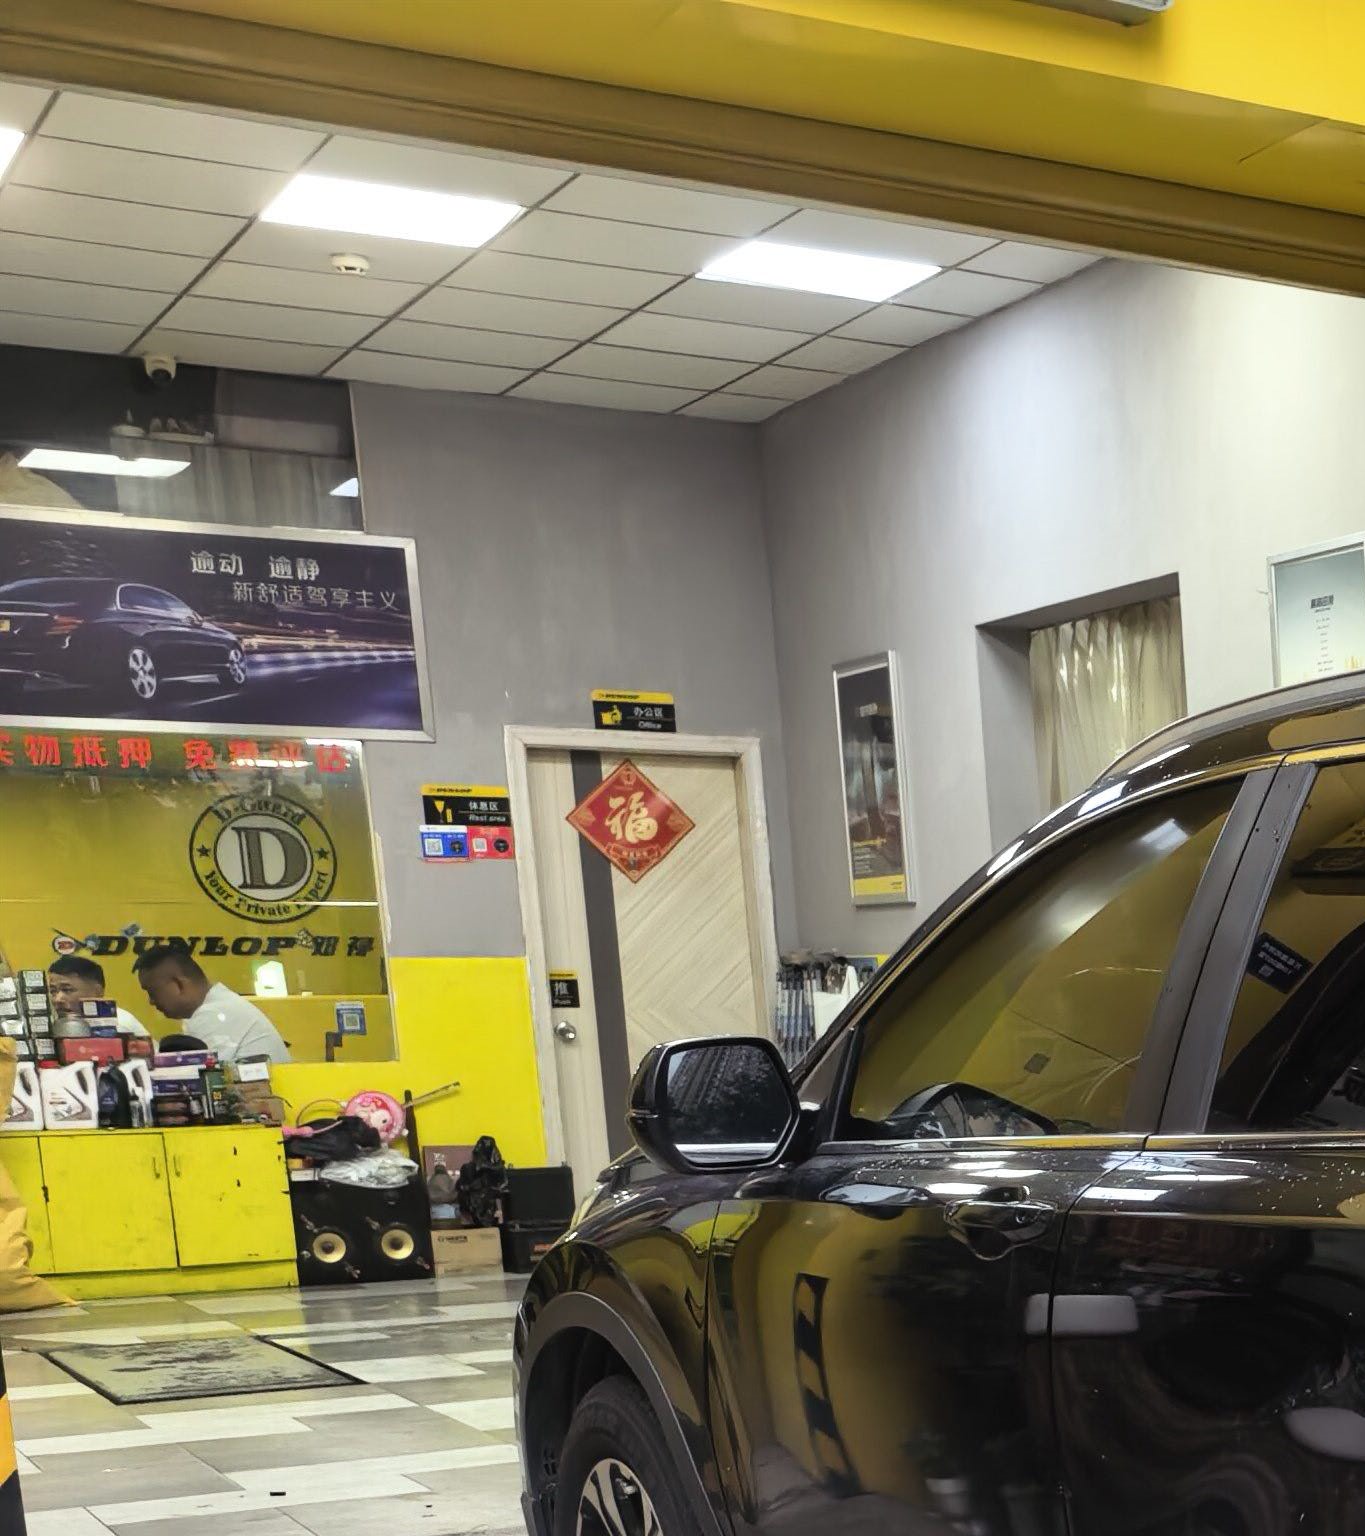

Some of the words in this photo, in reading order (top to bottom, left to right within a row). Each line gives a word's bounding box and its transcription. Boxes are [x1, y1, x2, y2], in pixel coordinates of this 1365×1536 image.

[233, 581, 400, 611] 新舒适驾享主义
[604, 791, 659, 844] 福
[231, 826, 308, 890] D
